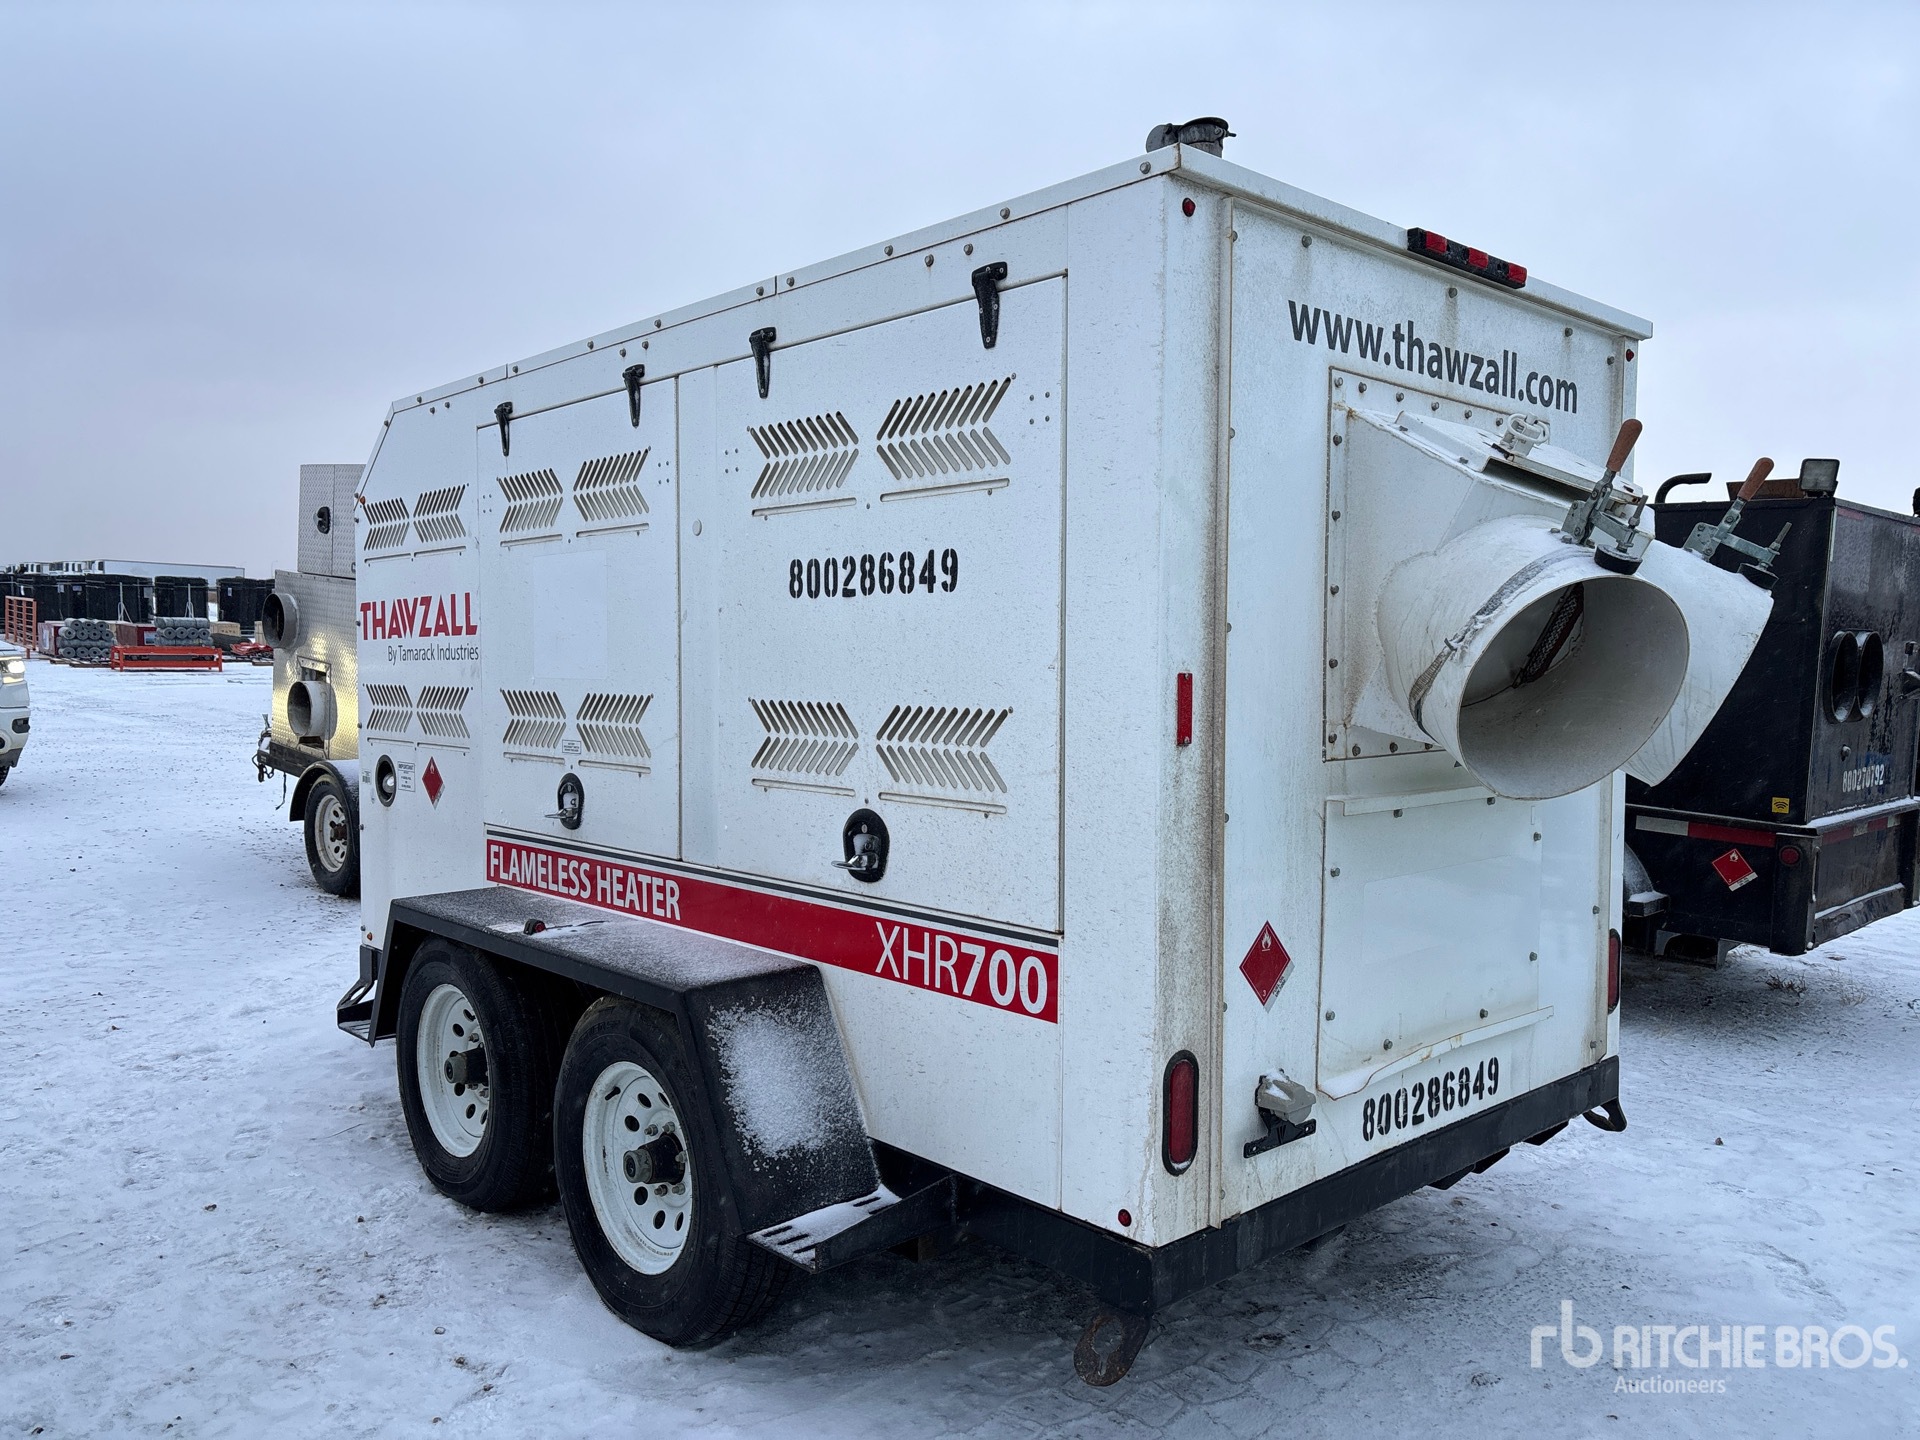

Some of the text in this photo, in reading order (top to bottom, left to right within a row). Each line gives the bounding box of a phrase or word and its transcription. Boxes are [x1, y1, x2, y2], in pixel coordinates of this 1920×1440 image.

[1288, 299, 1578, 414] www.thawzall.com
[789, 548, 959, 599] 800286849
[360, 592, 478, 640] THAWZALL
[387, 643, 479, 666] By Tamarack Industries
[490, 844, 681, 921] FLAMELESS HEATER
[875, 921, 1048, 1014] XHR700
[1363, 1056, 1499, 1142] 800286849
